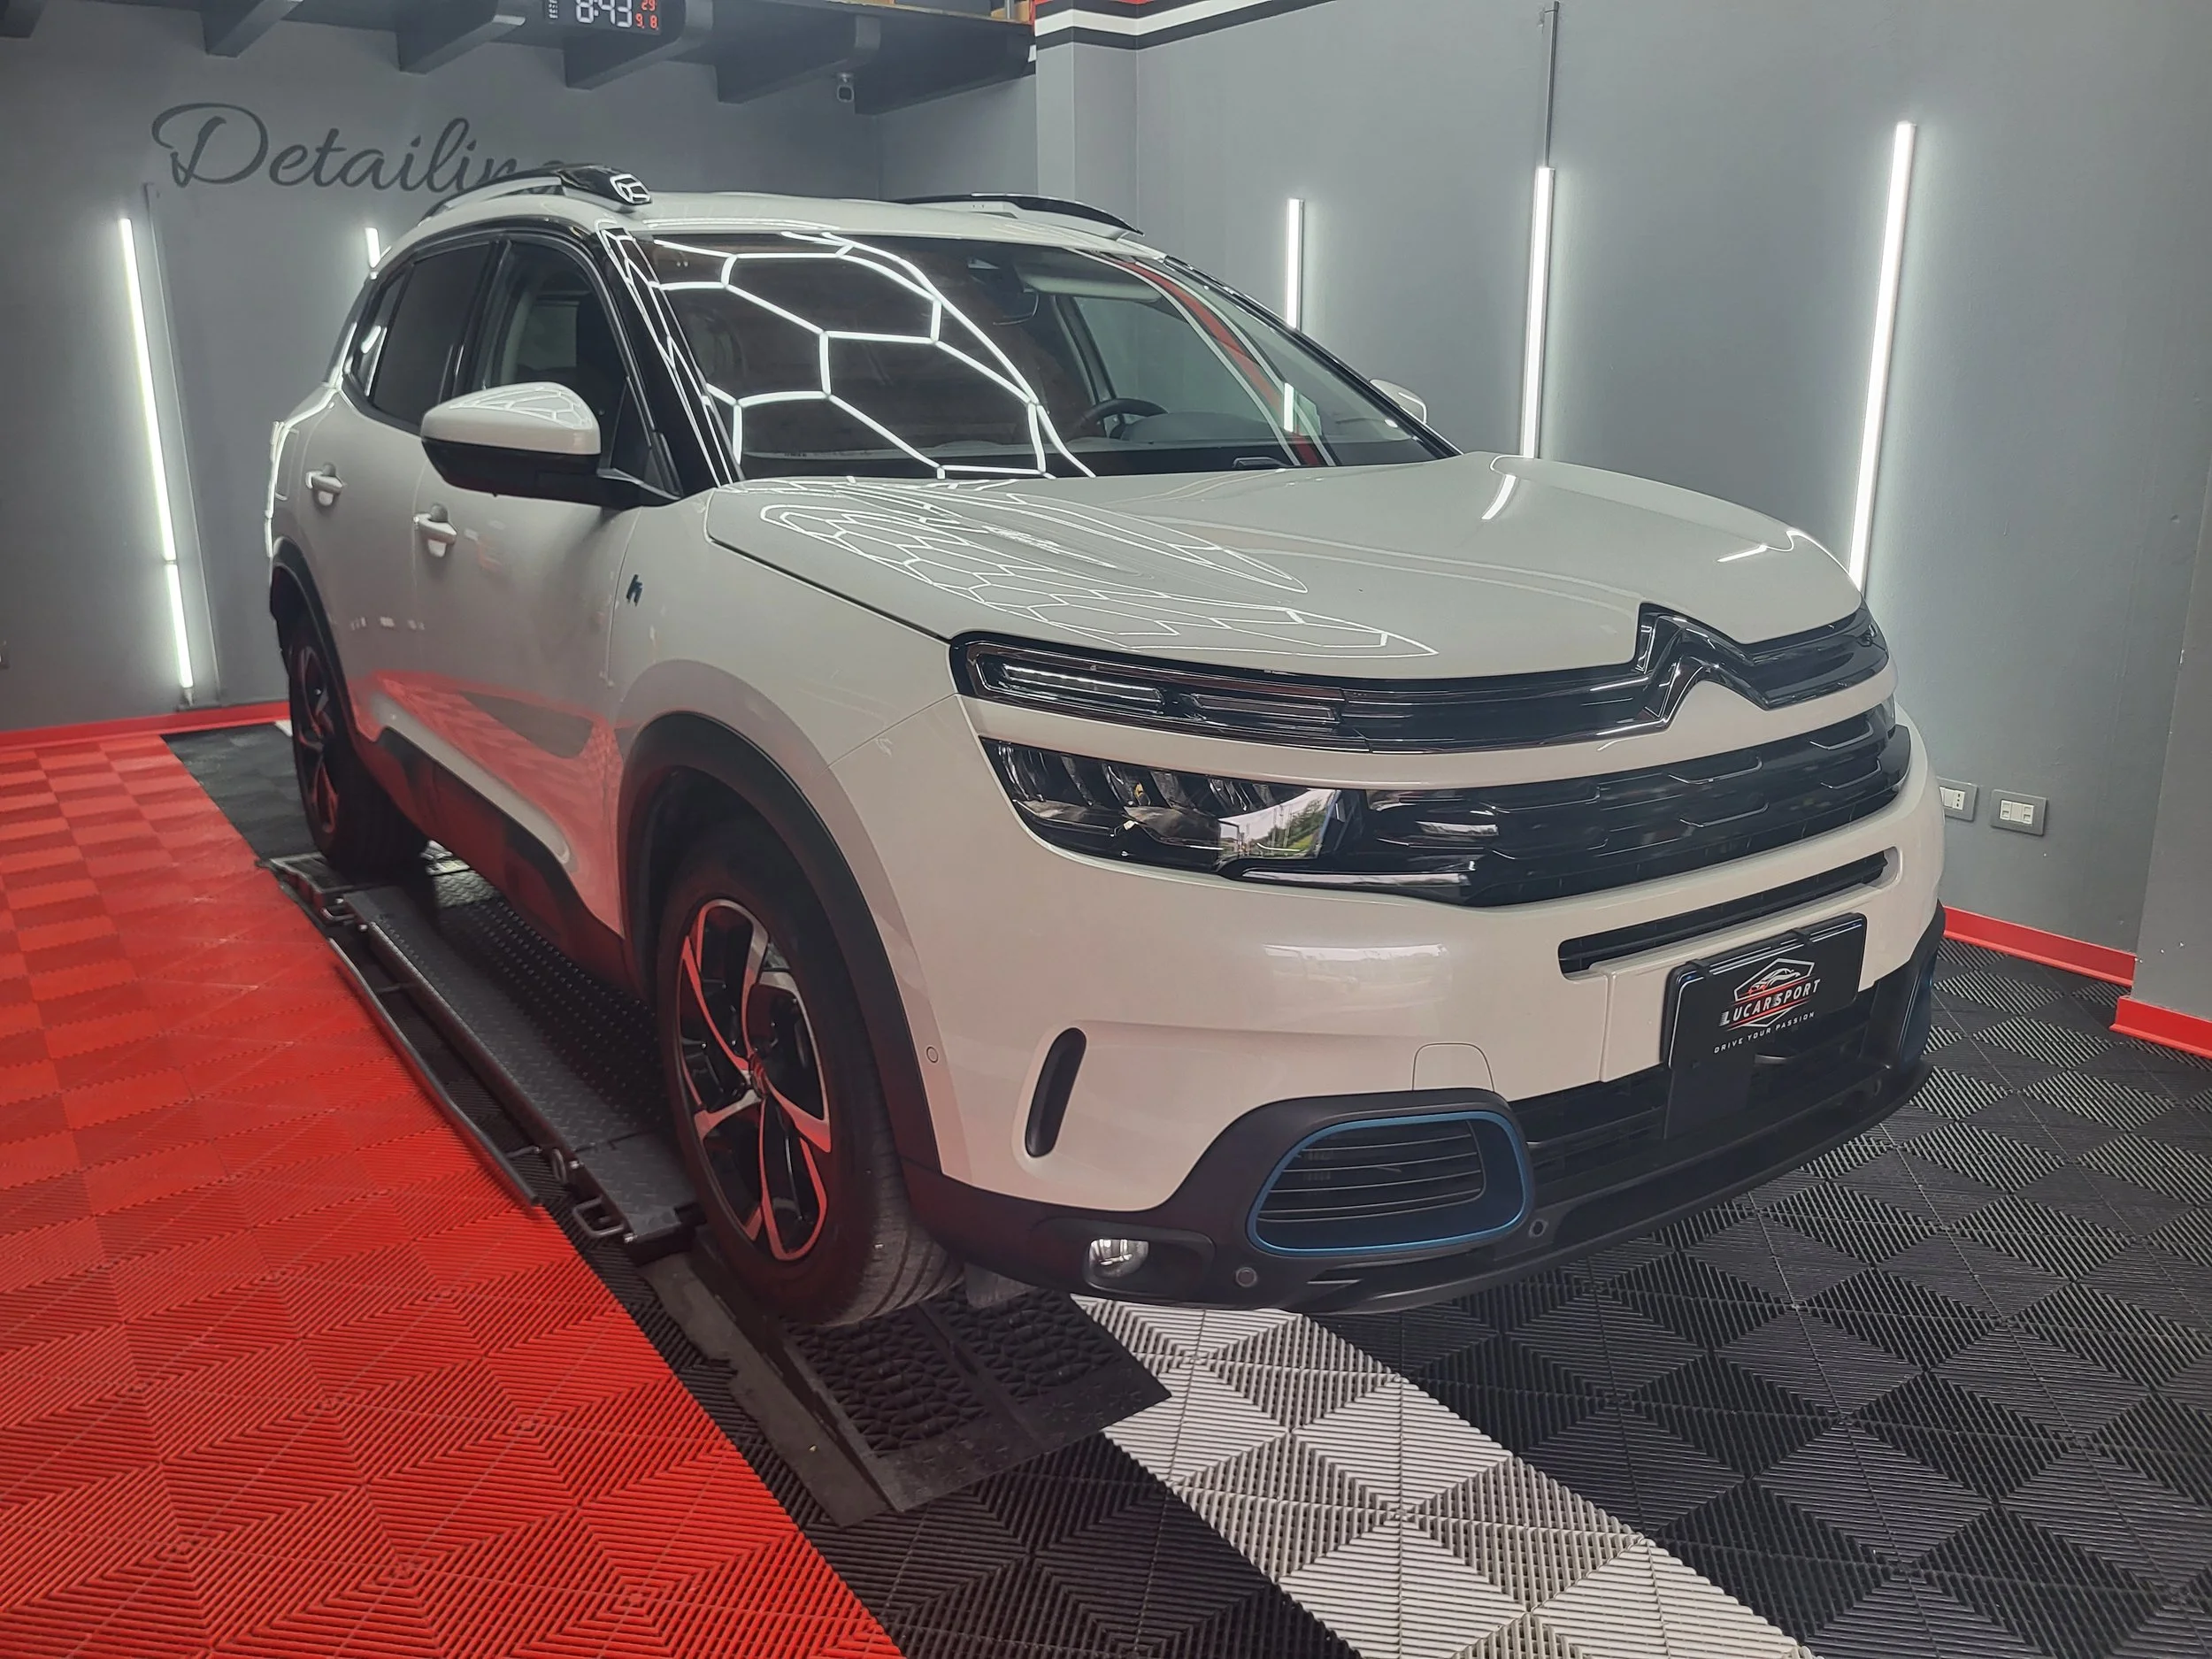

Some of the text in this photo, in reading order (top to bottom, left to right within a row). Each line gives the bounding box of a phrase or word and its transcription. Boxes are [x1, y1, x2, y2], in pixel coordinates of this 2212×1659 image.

[1718, 979, 1821, 1026] LUCARSPORT
[1714, 1011, 1815, 1054] DRIVE YOUR PASSION
